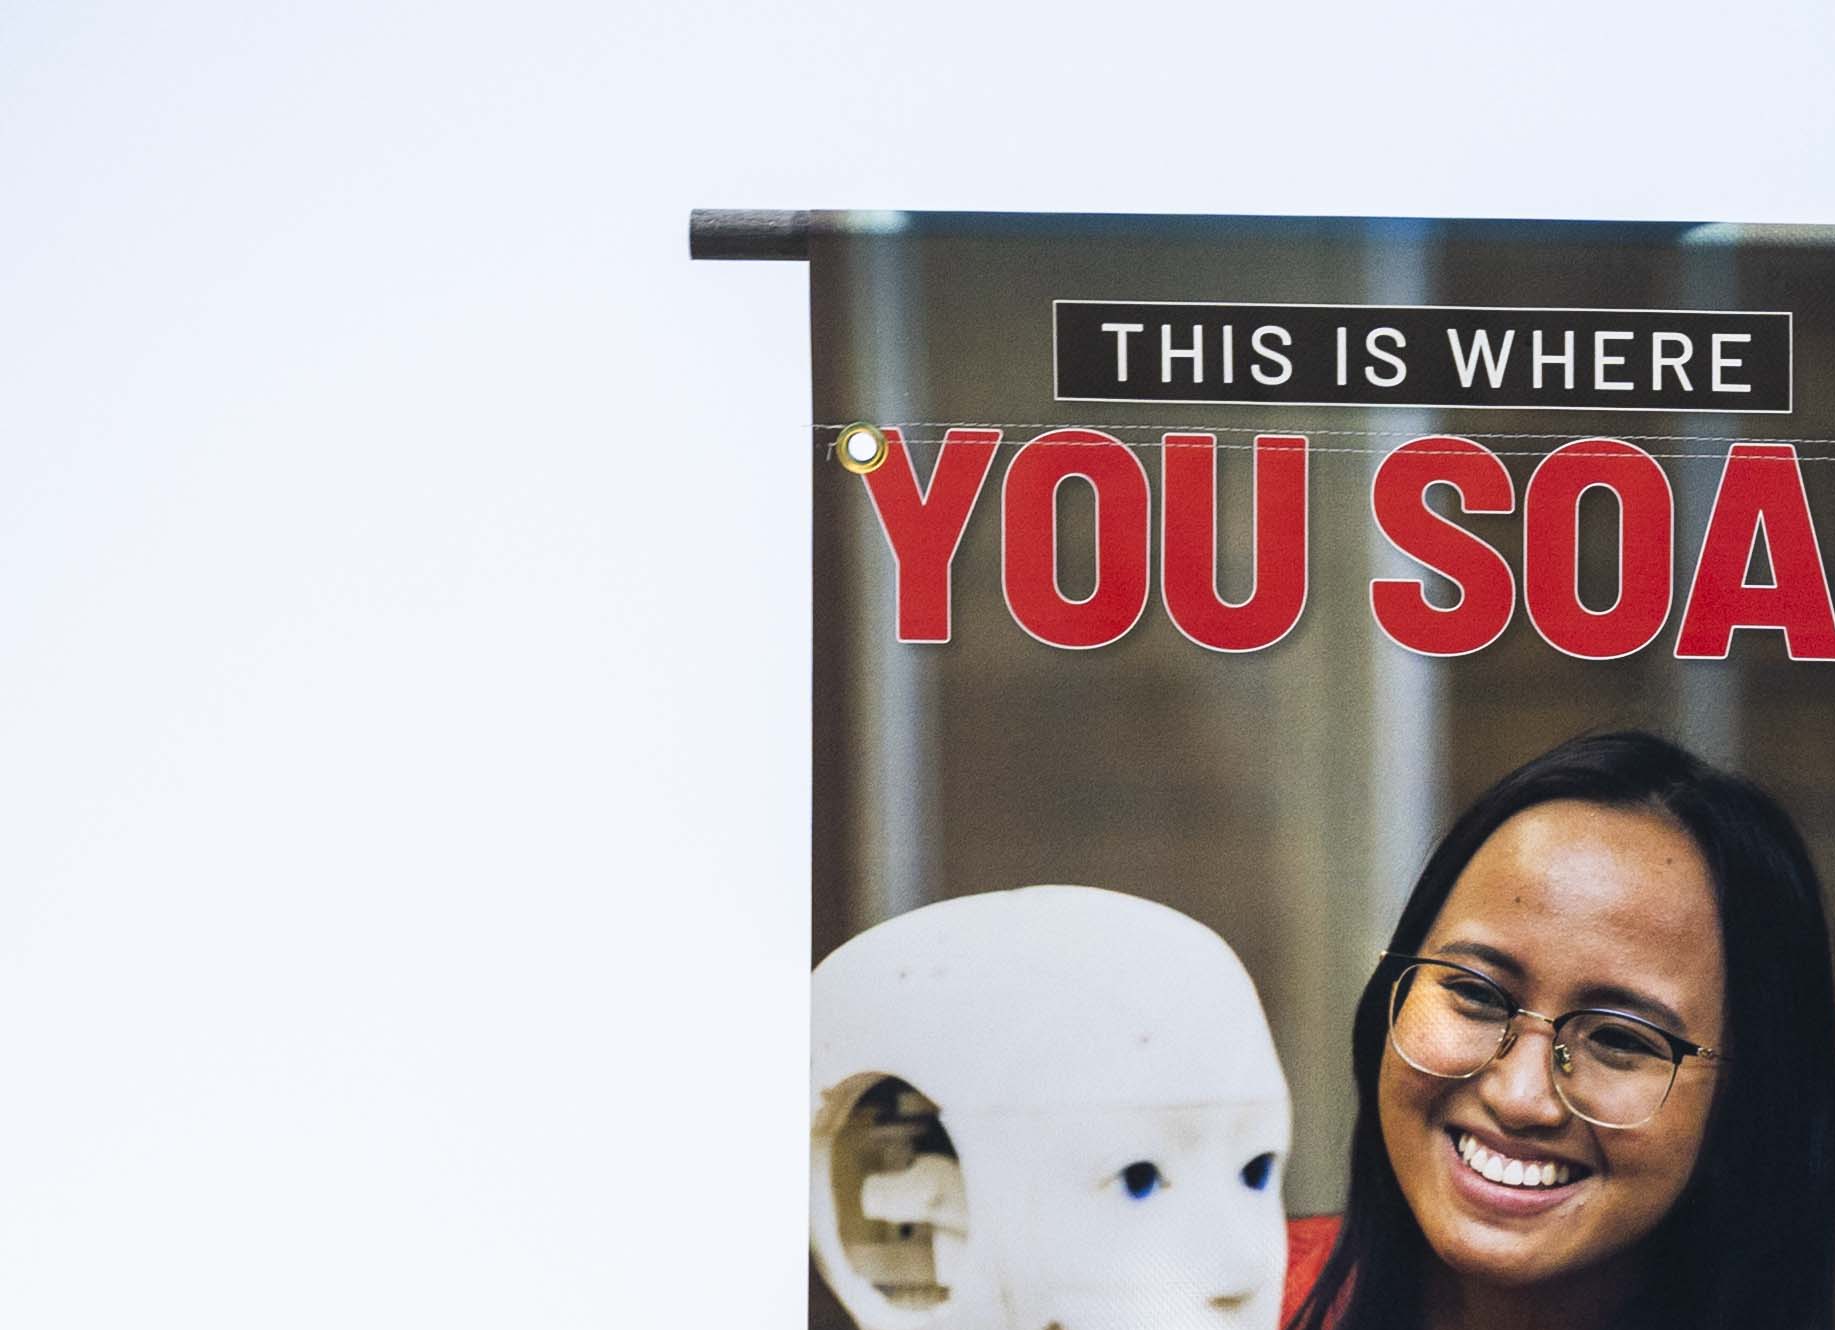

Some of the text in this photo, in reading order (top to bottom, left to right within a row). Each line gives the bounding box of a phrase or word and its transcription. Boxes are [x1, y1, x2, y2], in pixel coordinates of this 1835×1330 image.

[1101, 322, 1753, 393] THIS IS WHERE
[862, 428, 1308, 653] YOU
